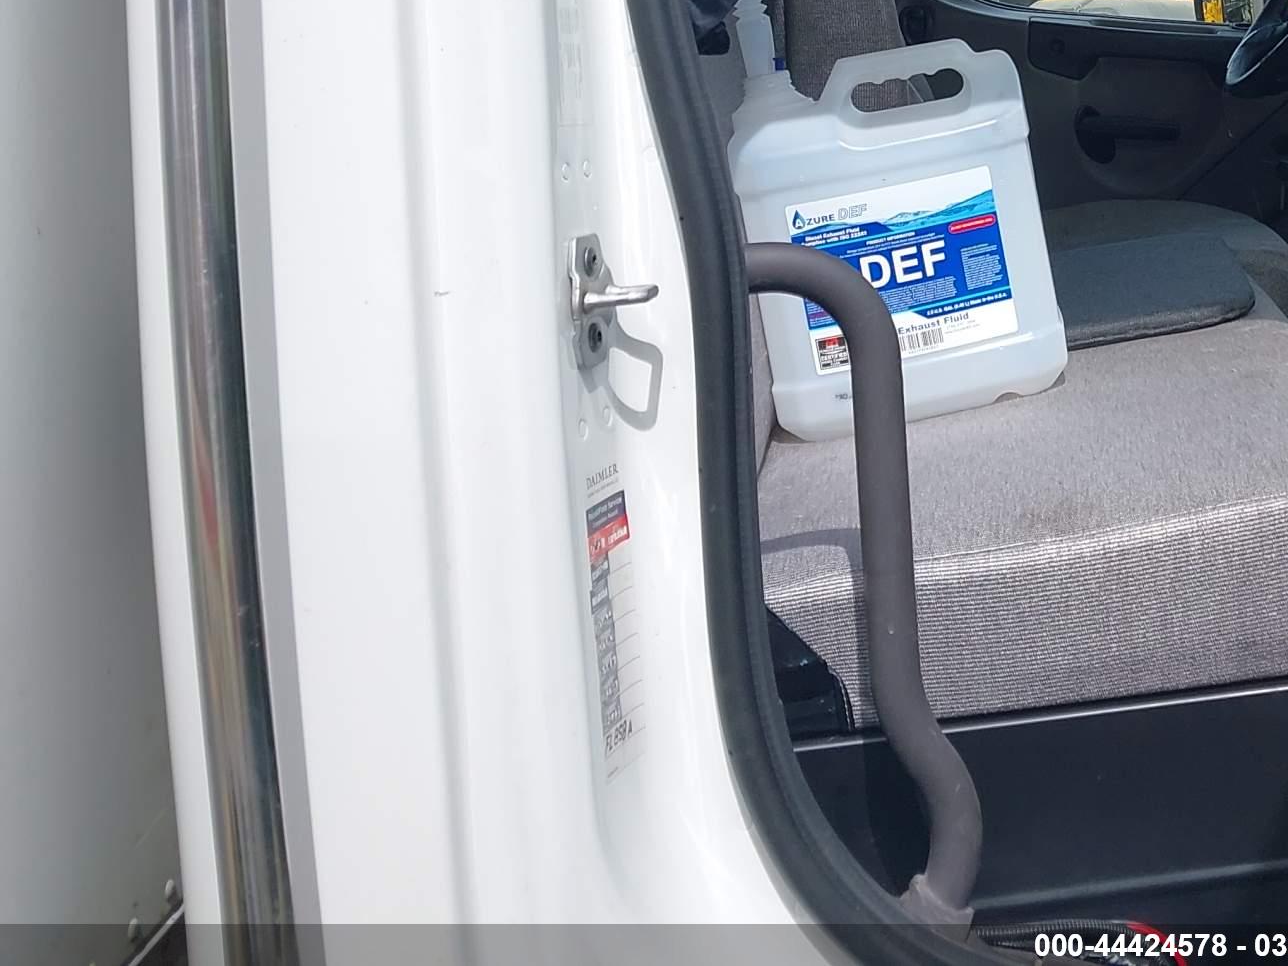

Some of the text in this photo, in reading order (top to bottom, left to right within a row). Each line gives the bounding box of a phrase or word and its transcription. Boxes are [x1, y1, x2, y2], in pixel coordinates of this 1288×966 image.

[838, 203, 868, 220] DEF
[859, 239, 946, 289] DEF
[898, 319, 941, 335] Exhaust
[943, 312, 969, 325] Fluid
[586, 464, 618, 490] DAIMLER
